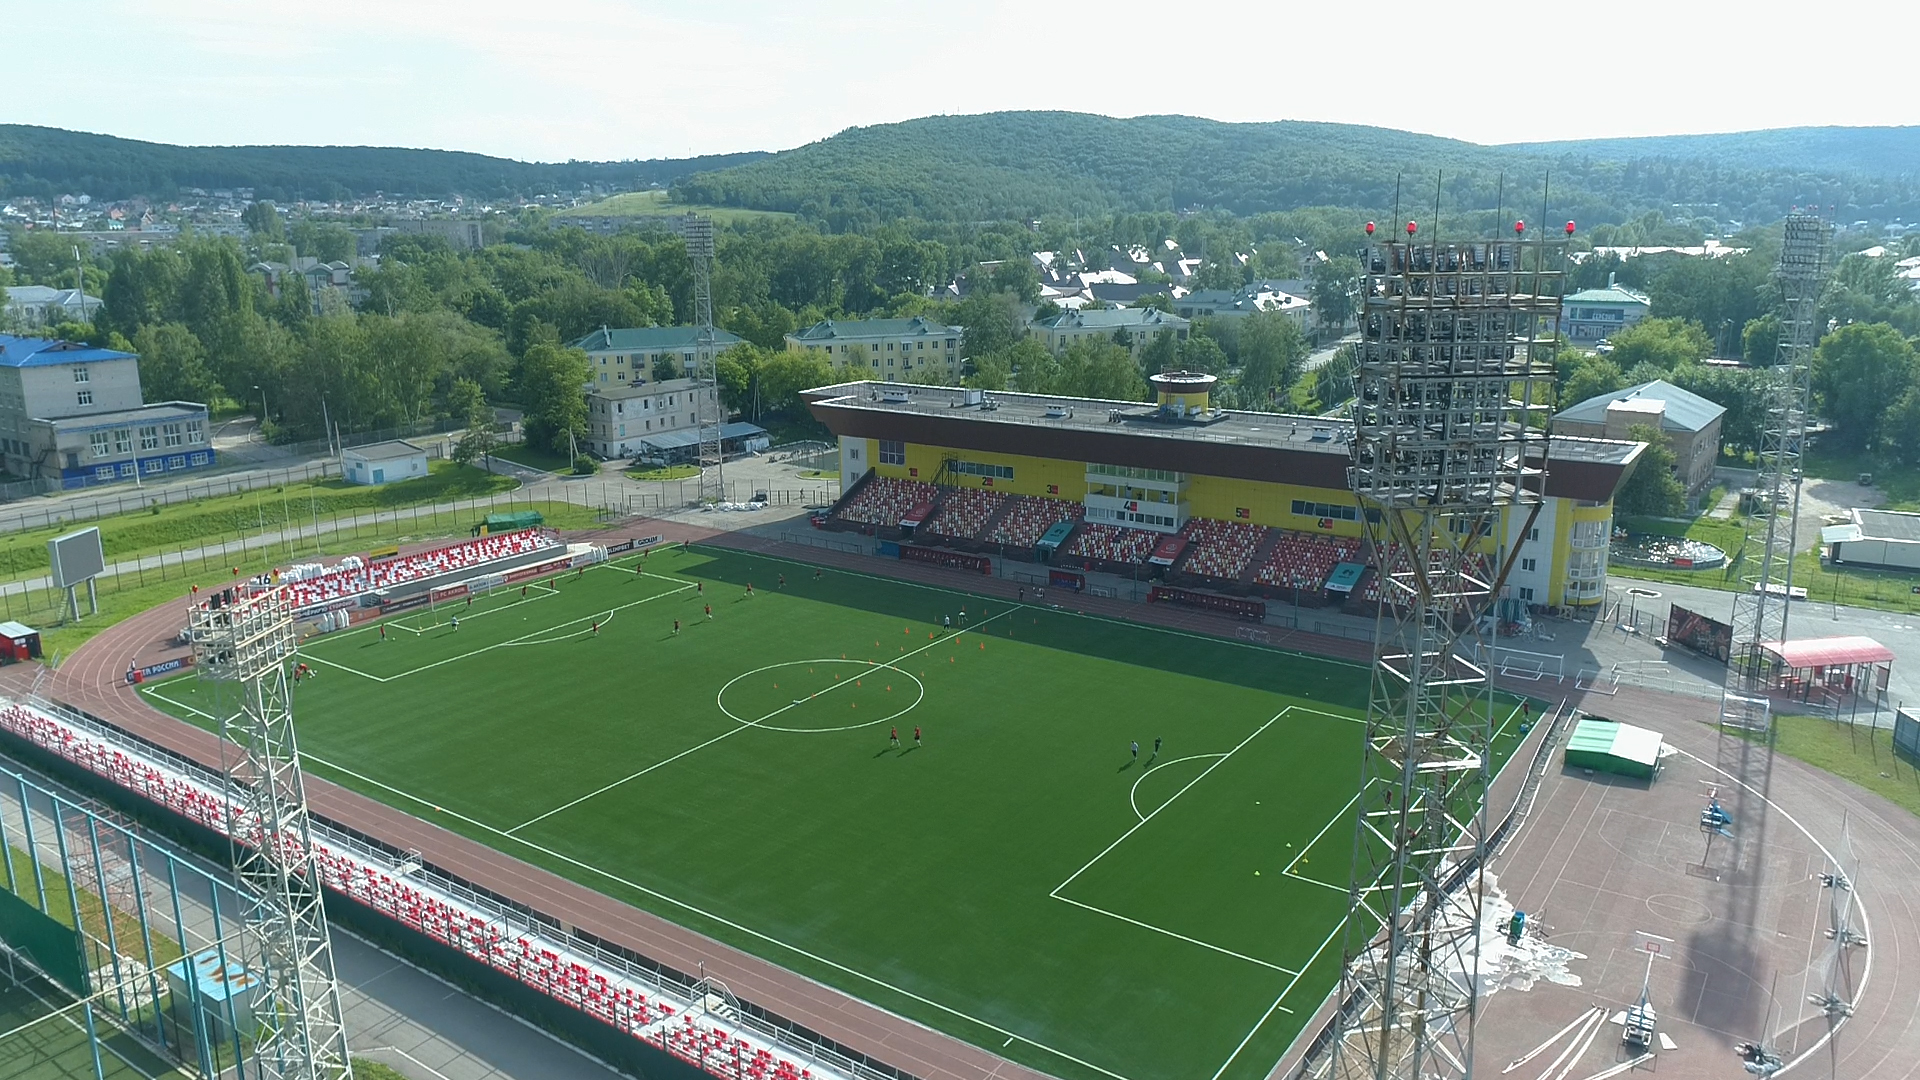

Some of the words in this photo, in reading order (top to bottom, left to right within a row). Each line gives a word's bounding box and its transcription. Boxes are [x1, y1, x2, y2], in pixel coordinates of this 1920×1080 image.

[1123, 501, 1130, 511] 4
[1235, 507, 1242, 518] 5
[1317, 518, 1324, 528] 6
[257, 573, 271, 585] 16
[152, 661, 179, 674] РОССИИ
